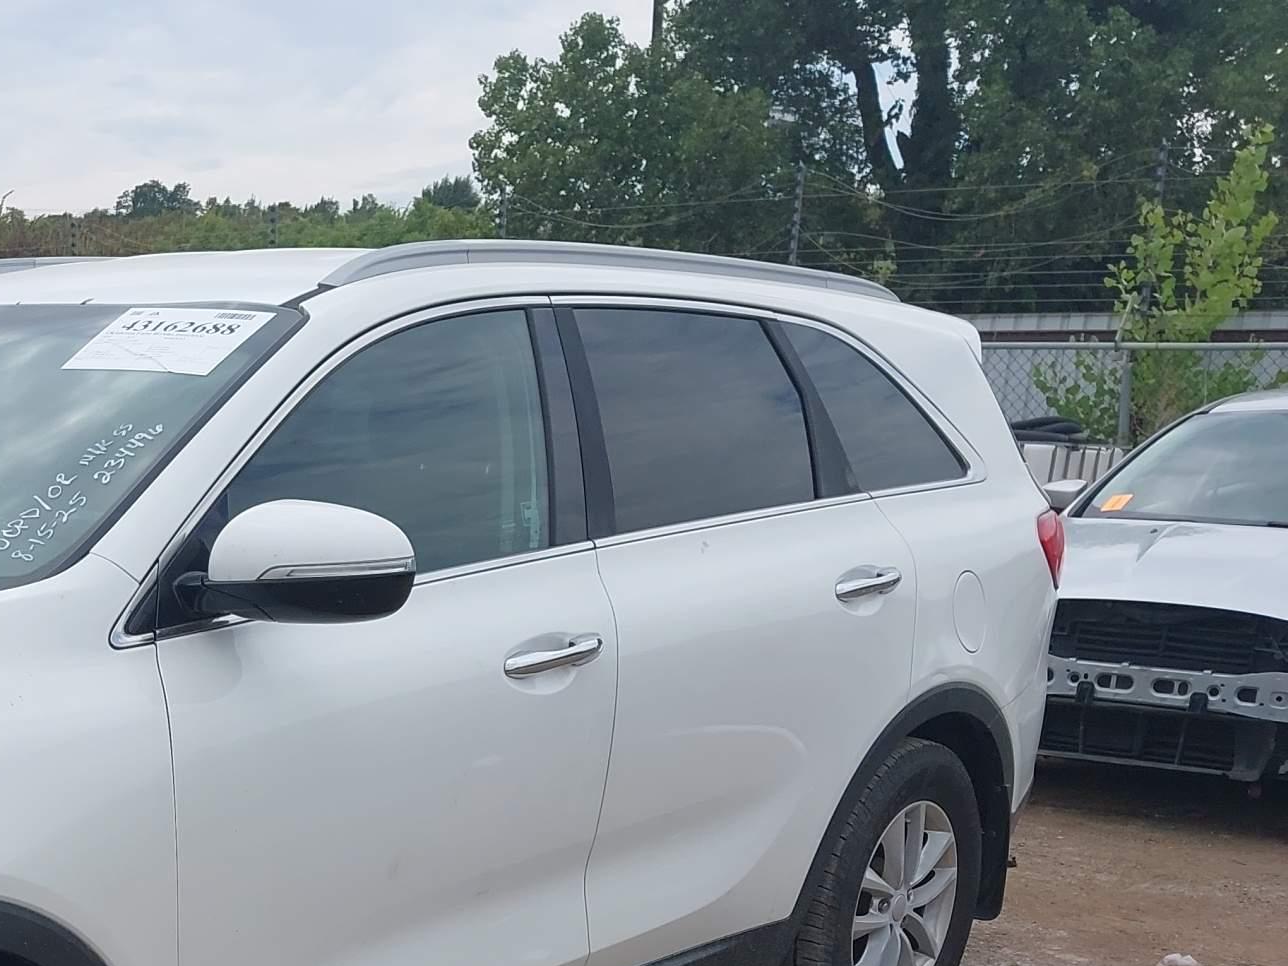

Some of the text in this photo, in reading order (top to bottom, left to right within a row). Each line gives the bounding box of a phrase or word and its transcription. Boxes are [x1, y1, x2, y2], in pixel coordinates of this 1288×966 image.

[122, 320, 240, 336] 43162688
[11, 424, 163, 561] 8-15-25 234496
